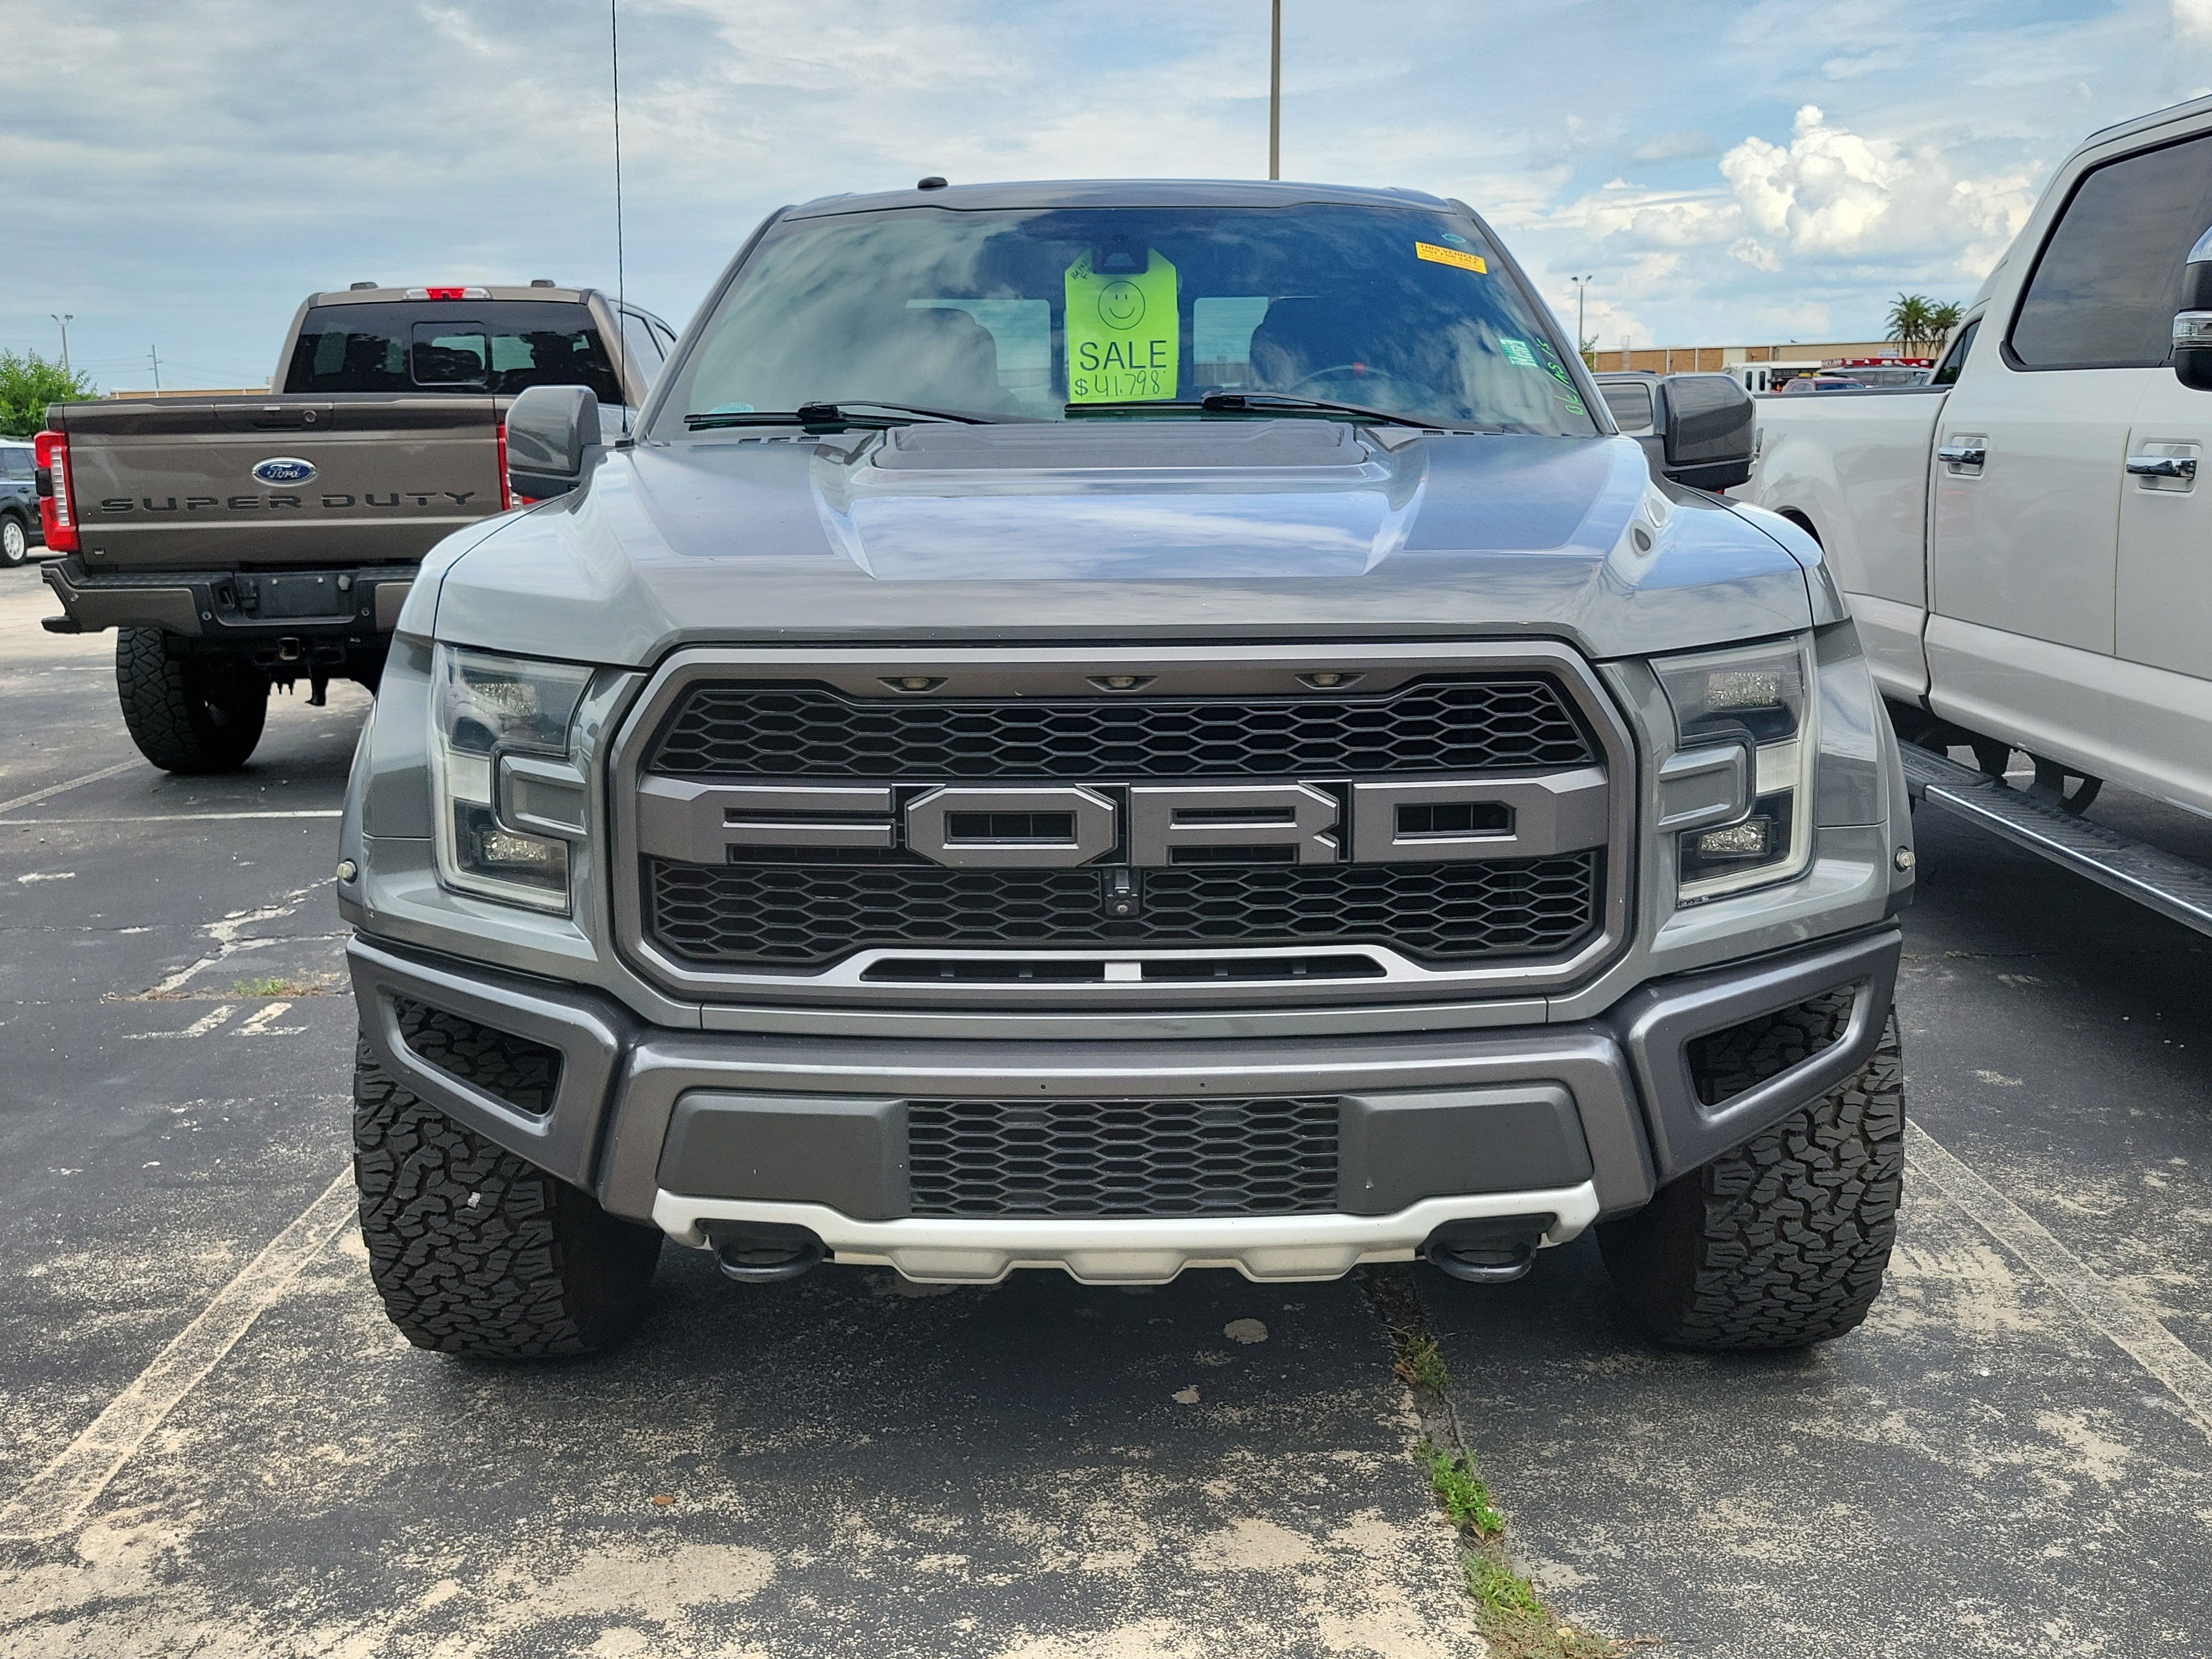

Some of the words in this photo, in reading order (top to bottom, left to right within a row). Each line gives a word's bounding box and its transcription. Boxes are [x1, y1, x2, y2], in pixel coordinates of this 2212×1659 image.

[1080, 340, 1167, 371] SALE
[267, 464, 302, 479] Ford
[101, 495, 302, 514] SUPER
[321, 492, 476, 509] DUTY
[637, 767, 1609, 867] FORD
